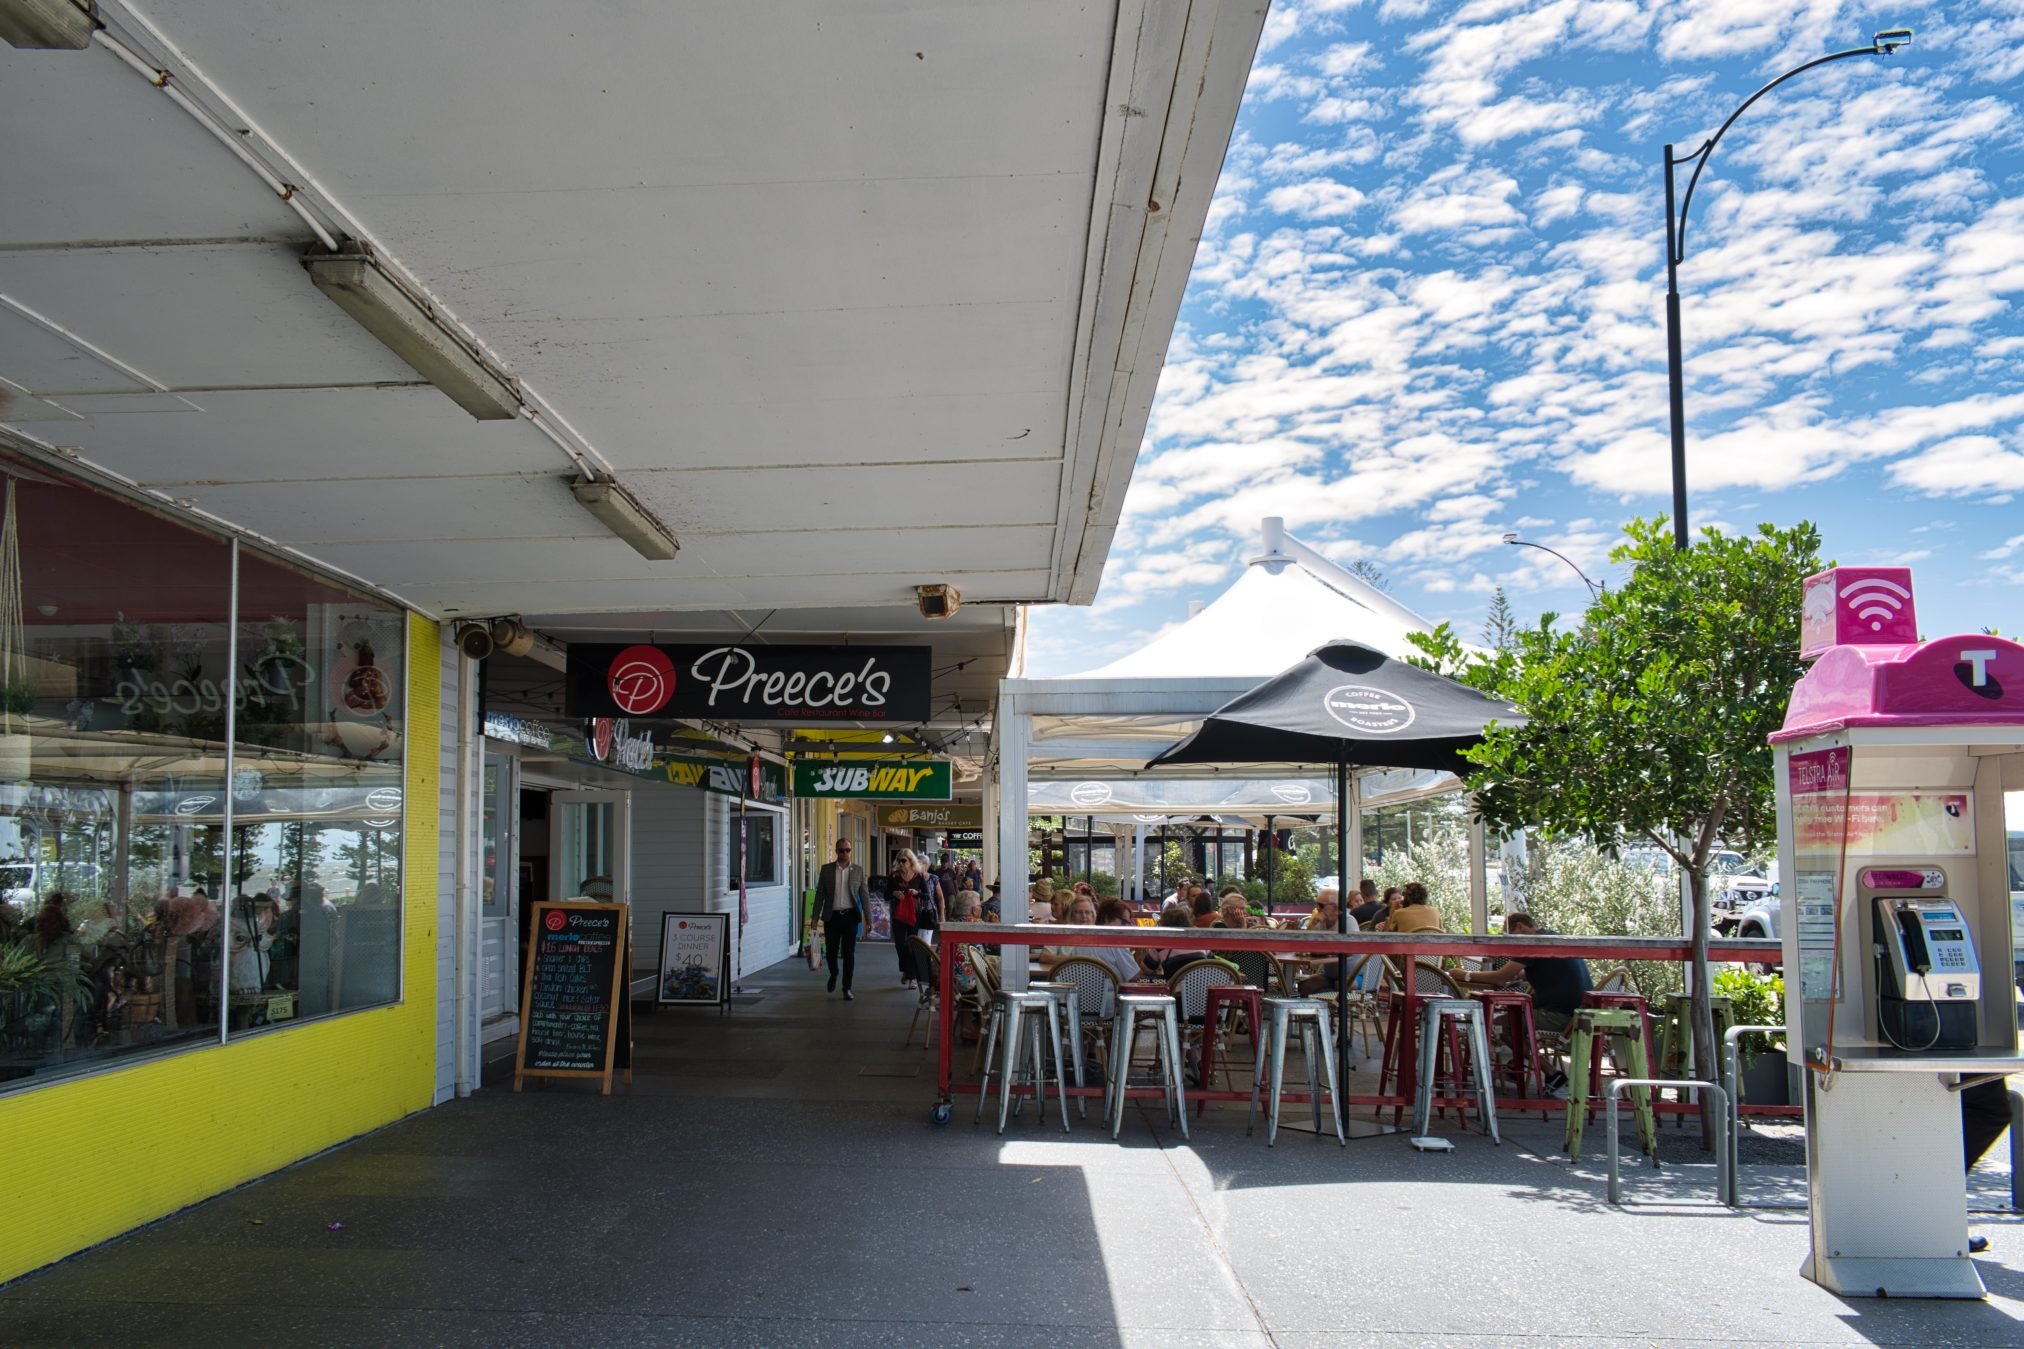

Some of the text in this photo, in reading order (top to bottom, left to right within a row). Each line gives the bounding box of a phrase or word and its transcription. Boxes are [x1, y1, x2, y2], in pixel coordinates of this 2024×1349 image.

[1960, 650, 1997, 687] T
[690, 647, 891, 707] Preece's
[1345, 691, 1382, 700] COFFEE
[801, 707, 848, 717] Restaurant
[849, 708, 871, 717] Wine
[873, 708, 887, 717] Bar
[1330, 701, 1406, 711] merlo
[1349, 716, 1399, 728] ROASTERS
[813, 767, 934, 792] SUBWAY
[1798, 764, 1826, 785] TELSTRA
[909, 807, 950, 824] Banjo's
[569, 915, 610, 927] Preece's
[680, 934, 716, 942] COURSE
[678, 942, 709, 950] DINNER
